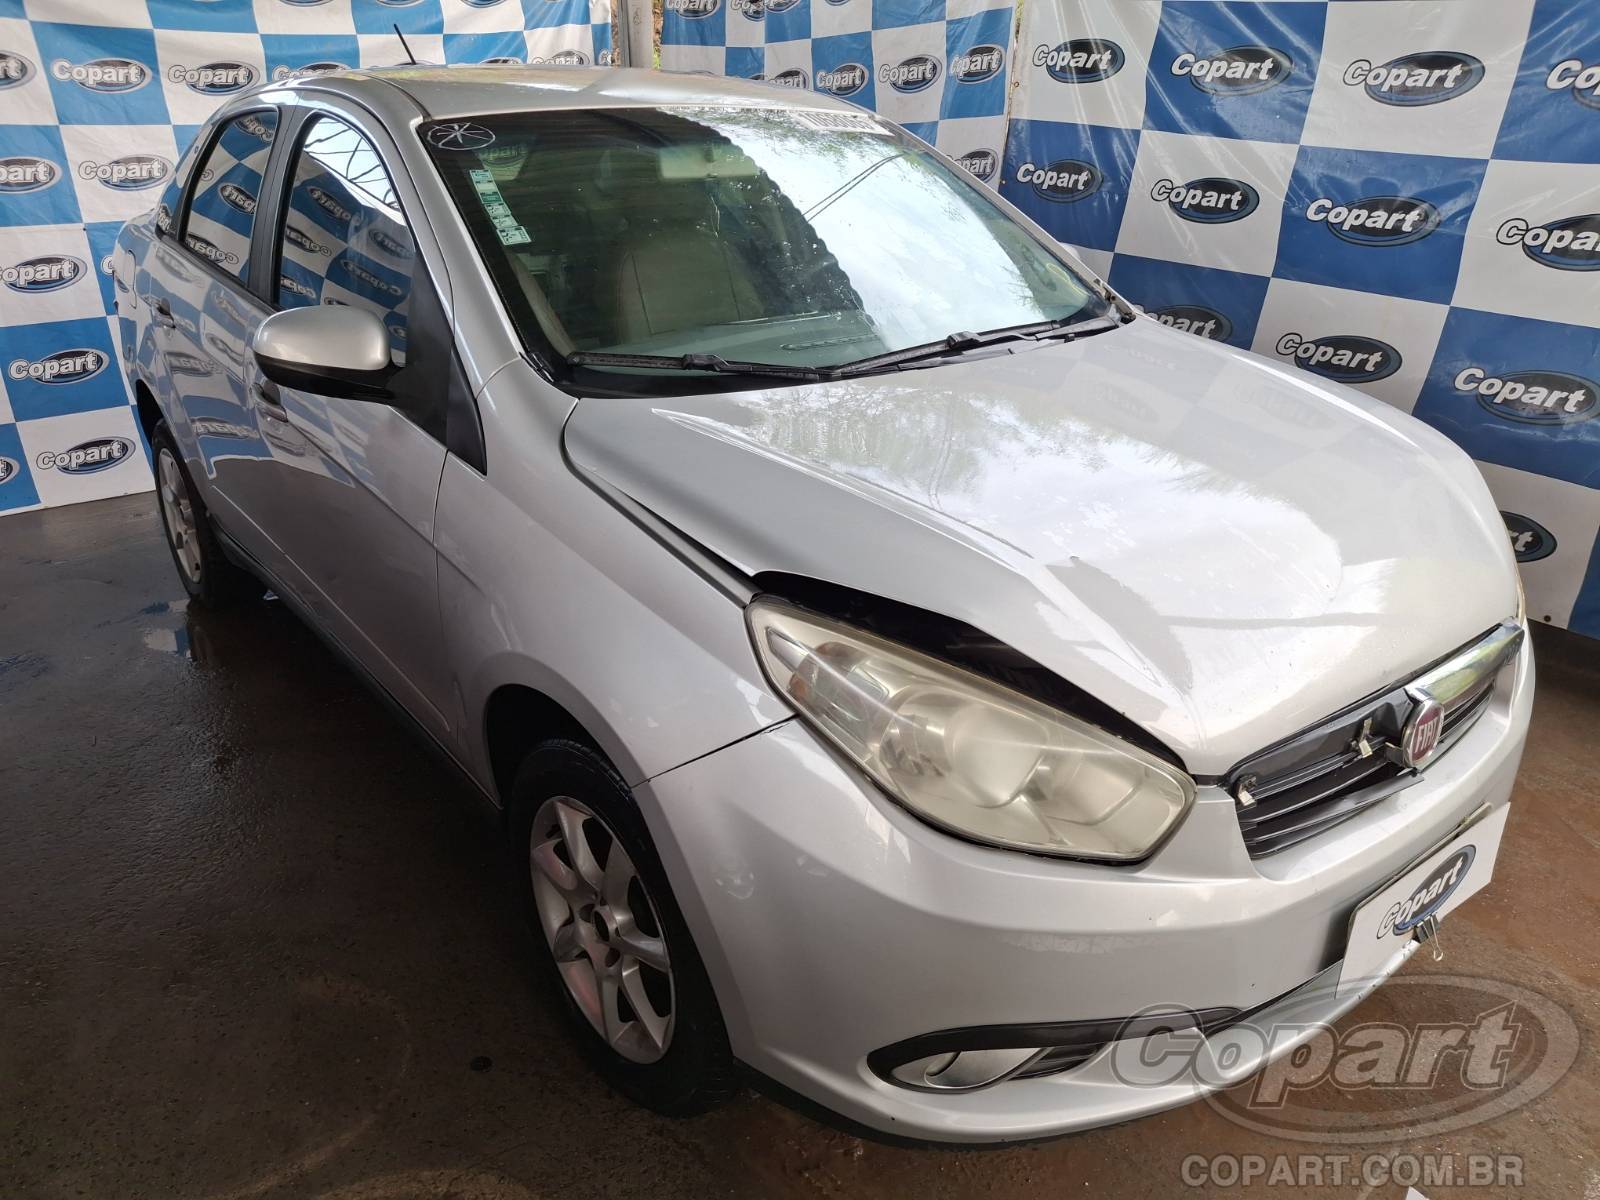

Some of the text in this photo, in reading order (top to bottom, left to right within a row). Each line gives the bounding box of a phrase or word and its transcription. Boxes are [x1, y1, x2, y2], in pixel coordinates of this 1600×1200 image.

[52, 58, 142, 85] Copart
[1033, 44, 1112, 71] Copart
[1171, 53, 1274, 82] Copart
[168, 64, 249, 88] Copart
[816, 68, 863, 91] Copart
[879, 59, 934, 88] Copart
[1343, 59, 1465, 92] Copart
[78, 159, 163, 182] Copart
[1016, 163, 1092, 191] Copart
[1151, 179, 1243, 211] Copart
[1306, 198, 1420, 233] Copart
[1496, 217, 1600, 254] Copa
[0, 258, 74, 288] opart
[9, 352, 98, 381] Copart
[1276, 332, 1383, 373] Copart
[1454, 366, 1586, 414] Copart
[36, 439, 123, 471] Copart
[1414, 717, 1440, 754] FIAT
[1377, 854, 1464, 940] Copart
